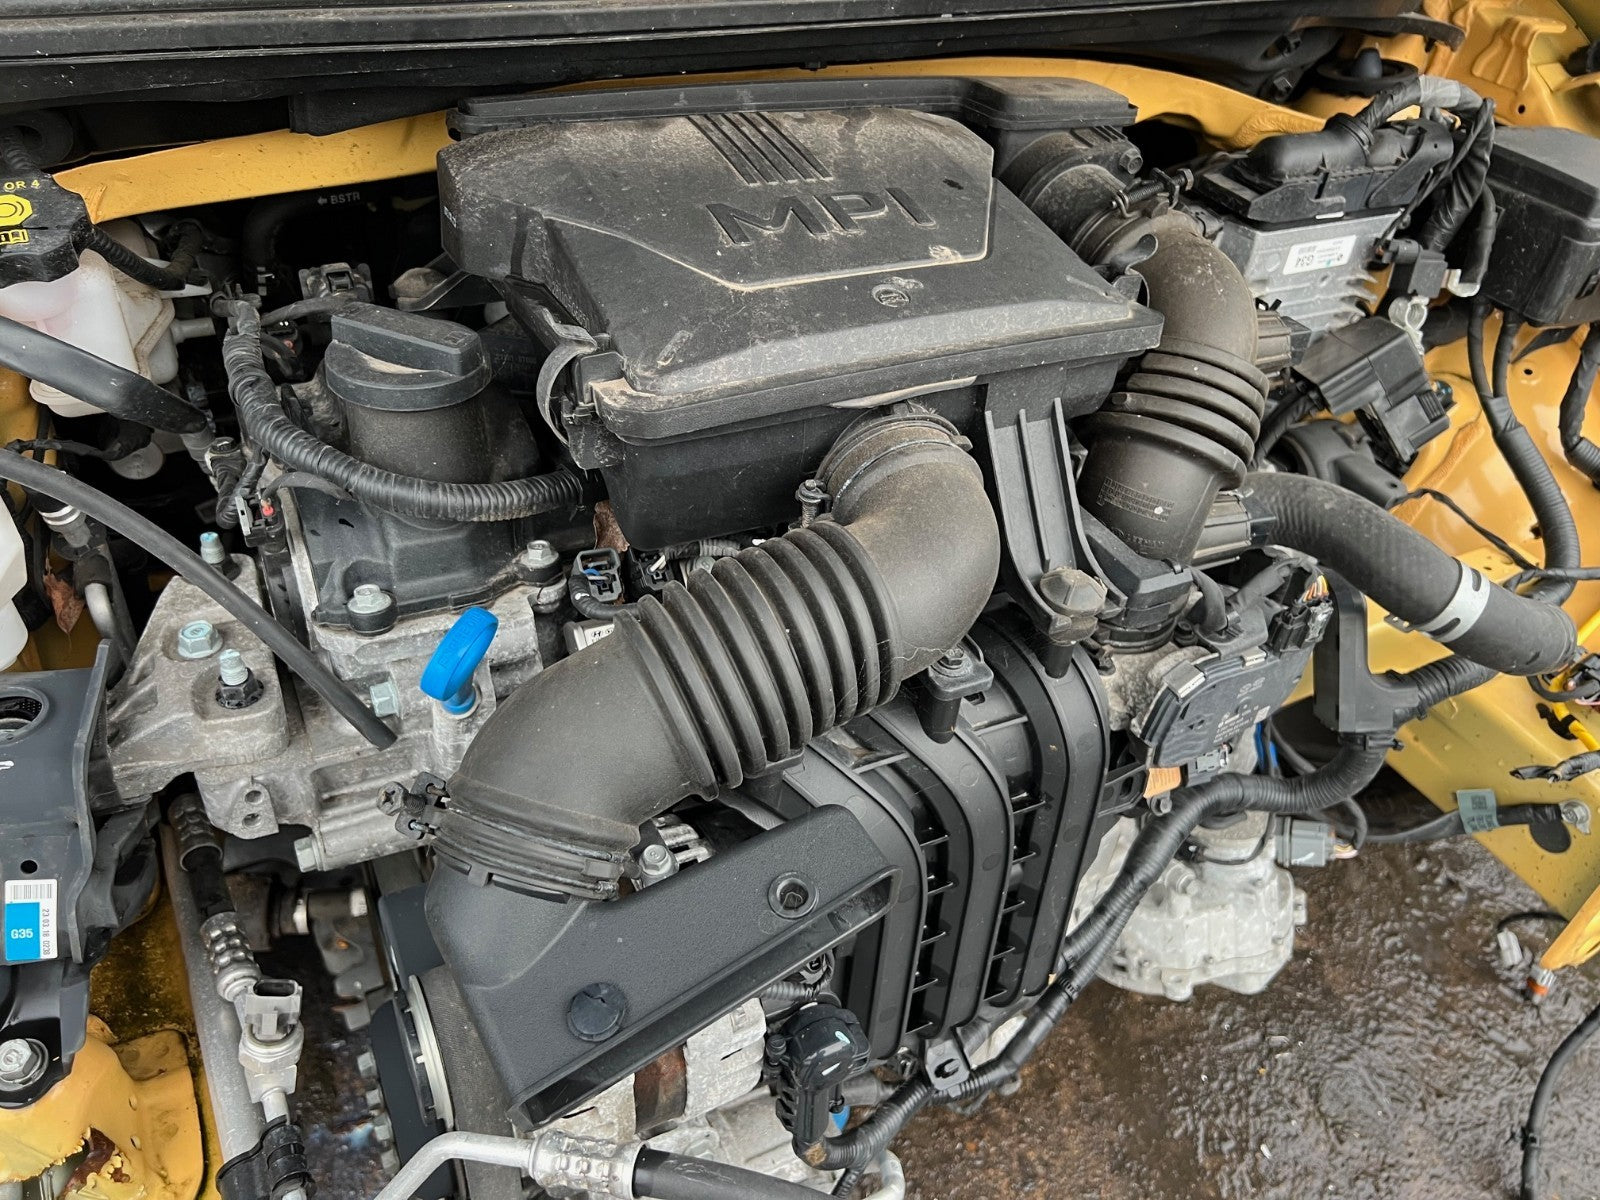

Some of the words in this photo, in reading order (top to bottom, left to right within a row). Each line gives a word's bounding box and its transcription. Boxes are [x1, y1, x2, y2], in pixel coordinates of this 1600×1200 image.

[4, 181, 27, 193] OR
[31, 179, 40, 190] 4
[330, 191, 361, 205] BSTR
[705, 186, 937, 247] MPI
[10, 928, 34, 940] G35
